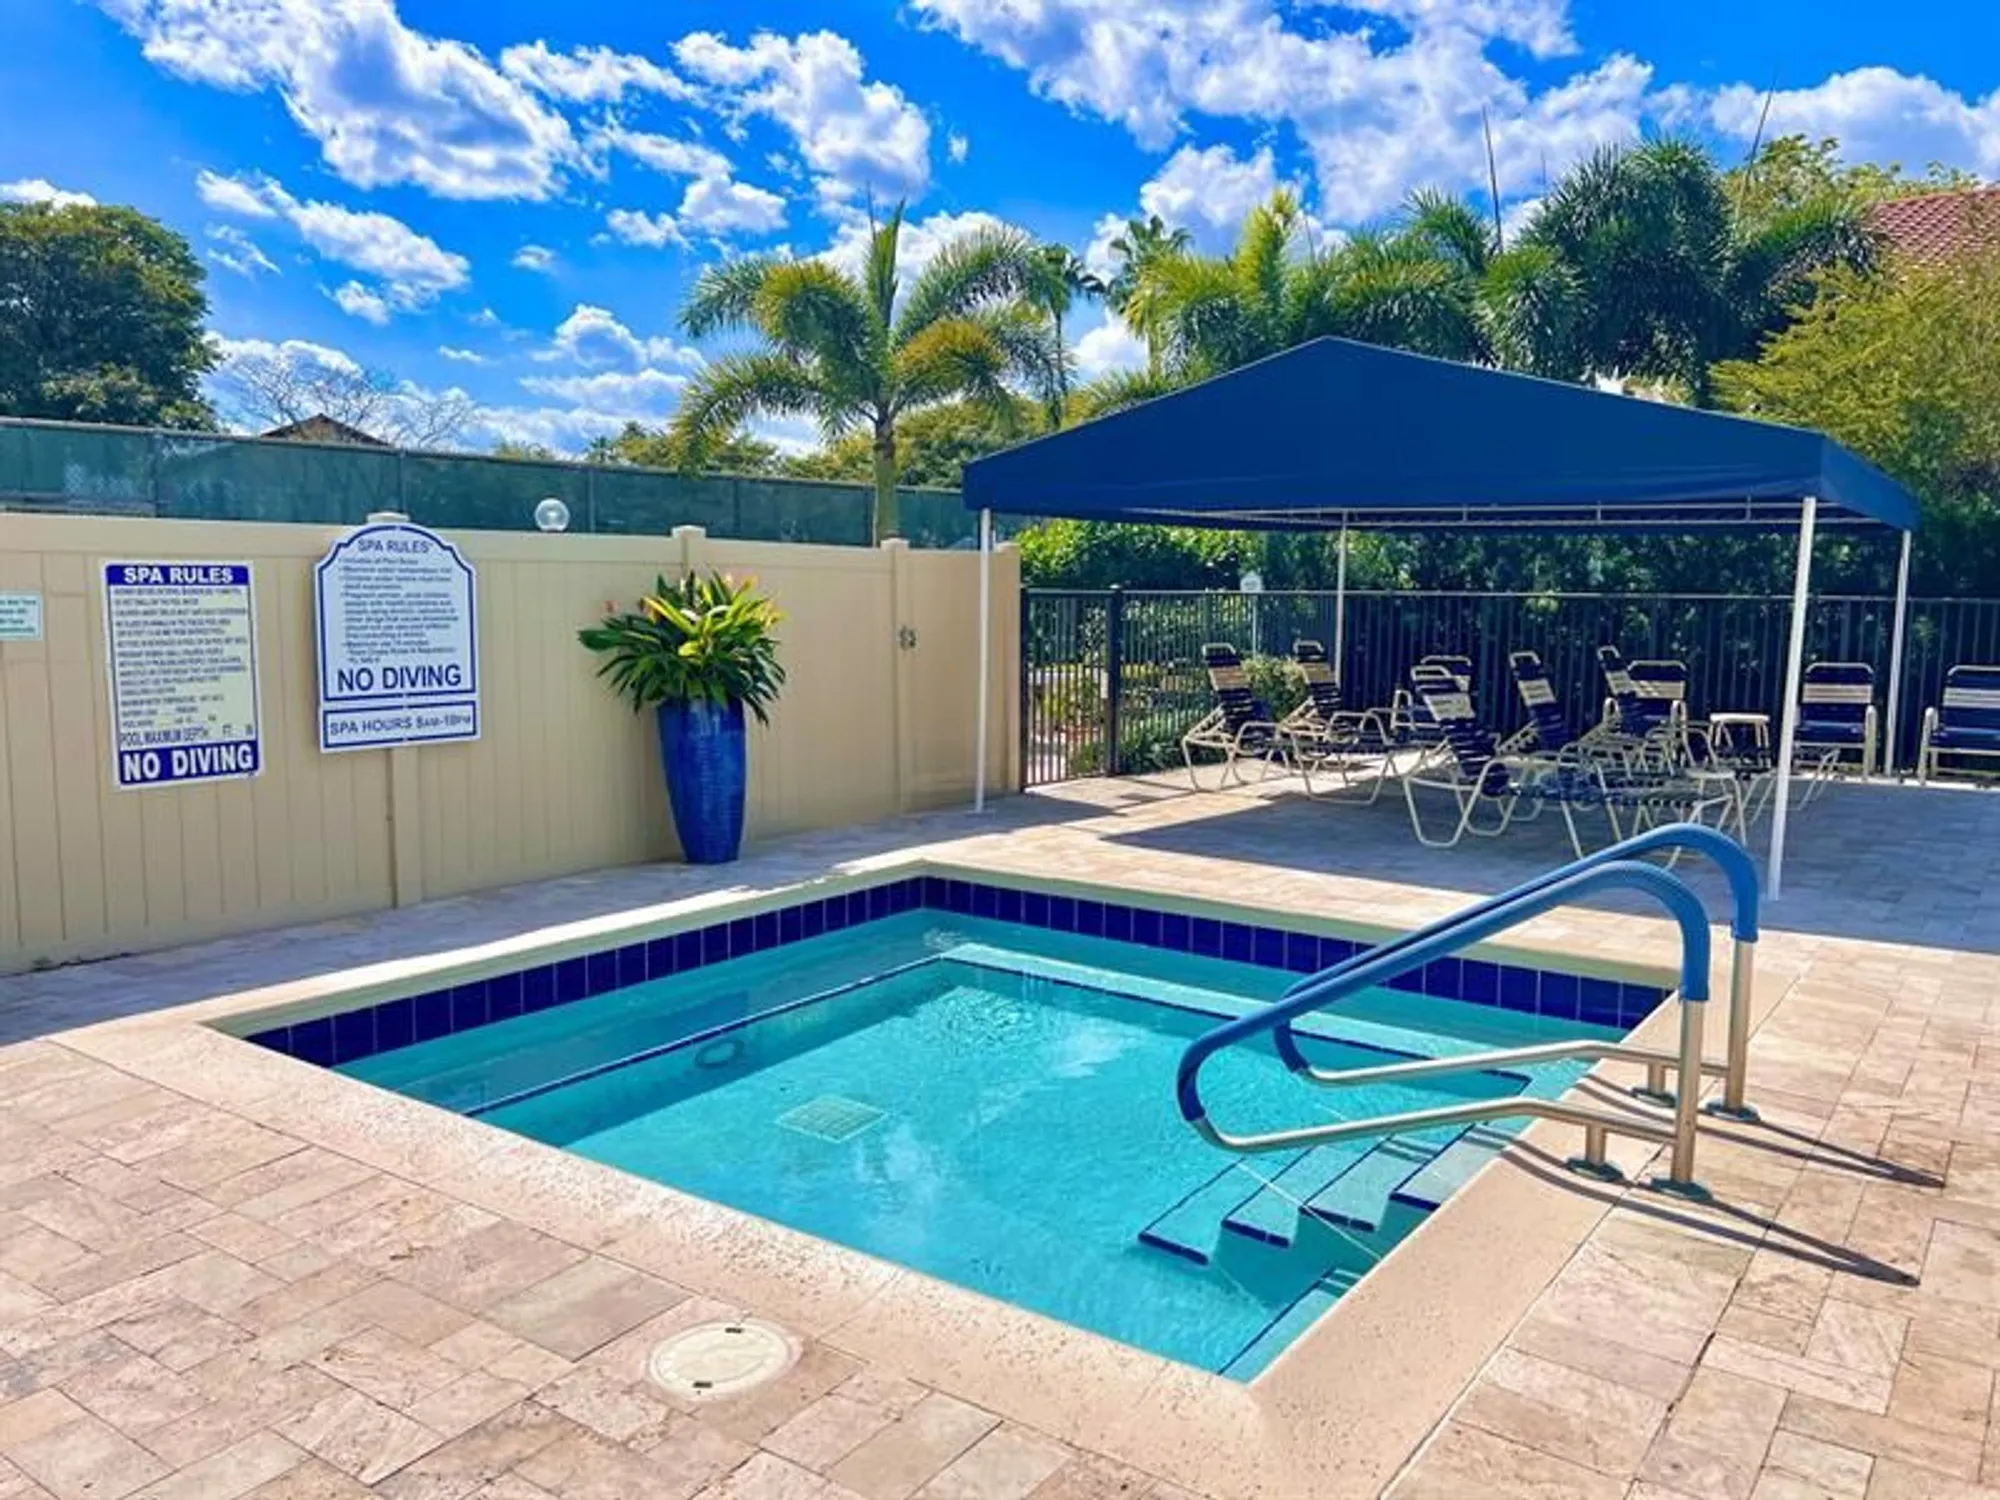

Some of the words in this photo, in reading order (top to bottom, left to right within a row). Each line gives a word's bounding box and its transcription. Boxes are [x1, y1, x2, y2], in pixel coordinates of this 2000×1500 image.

[357, 539, 384, 553] SPA
[123, 566, 164, 583] SPA
[169, 566, 234, 583] RULES
[337, 667, 374, 692] NO
[382, 662, 462, 689] DIVING
[329, 720, 359, 736] SPA
[362, 716, 413, 733] HOURS
[122, 751, 161, 781] NO
[171, 743, 254, 777] DIVING
